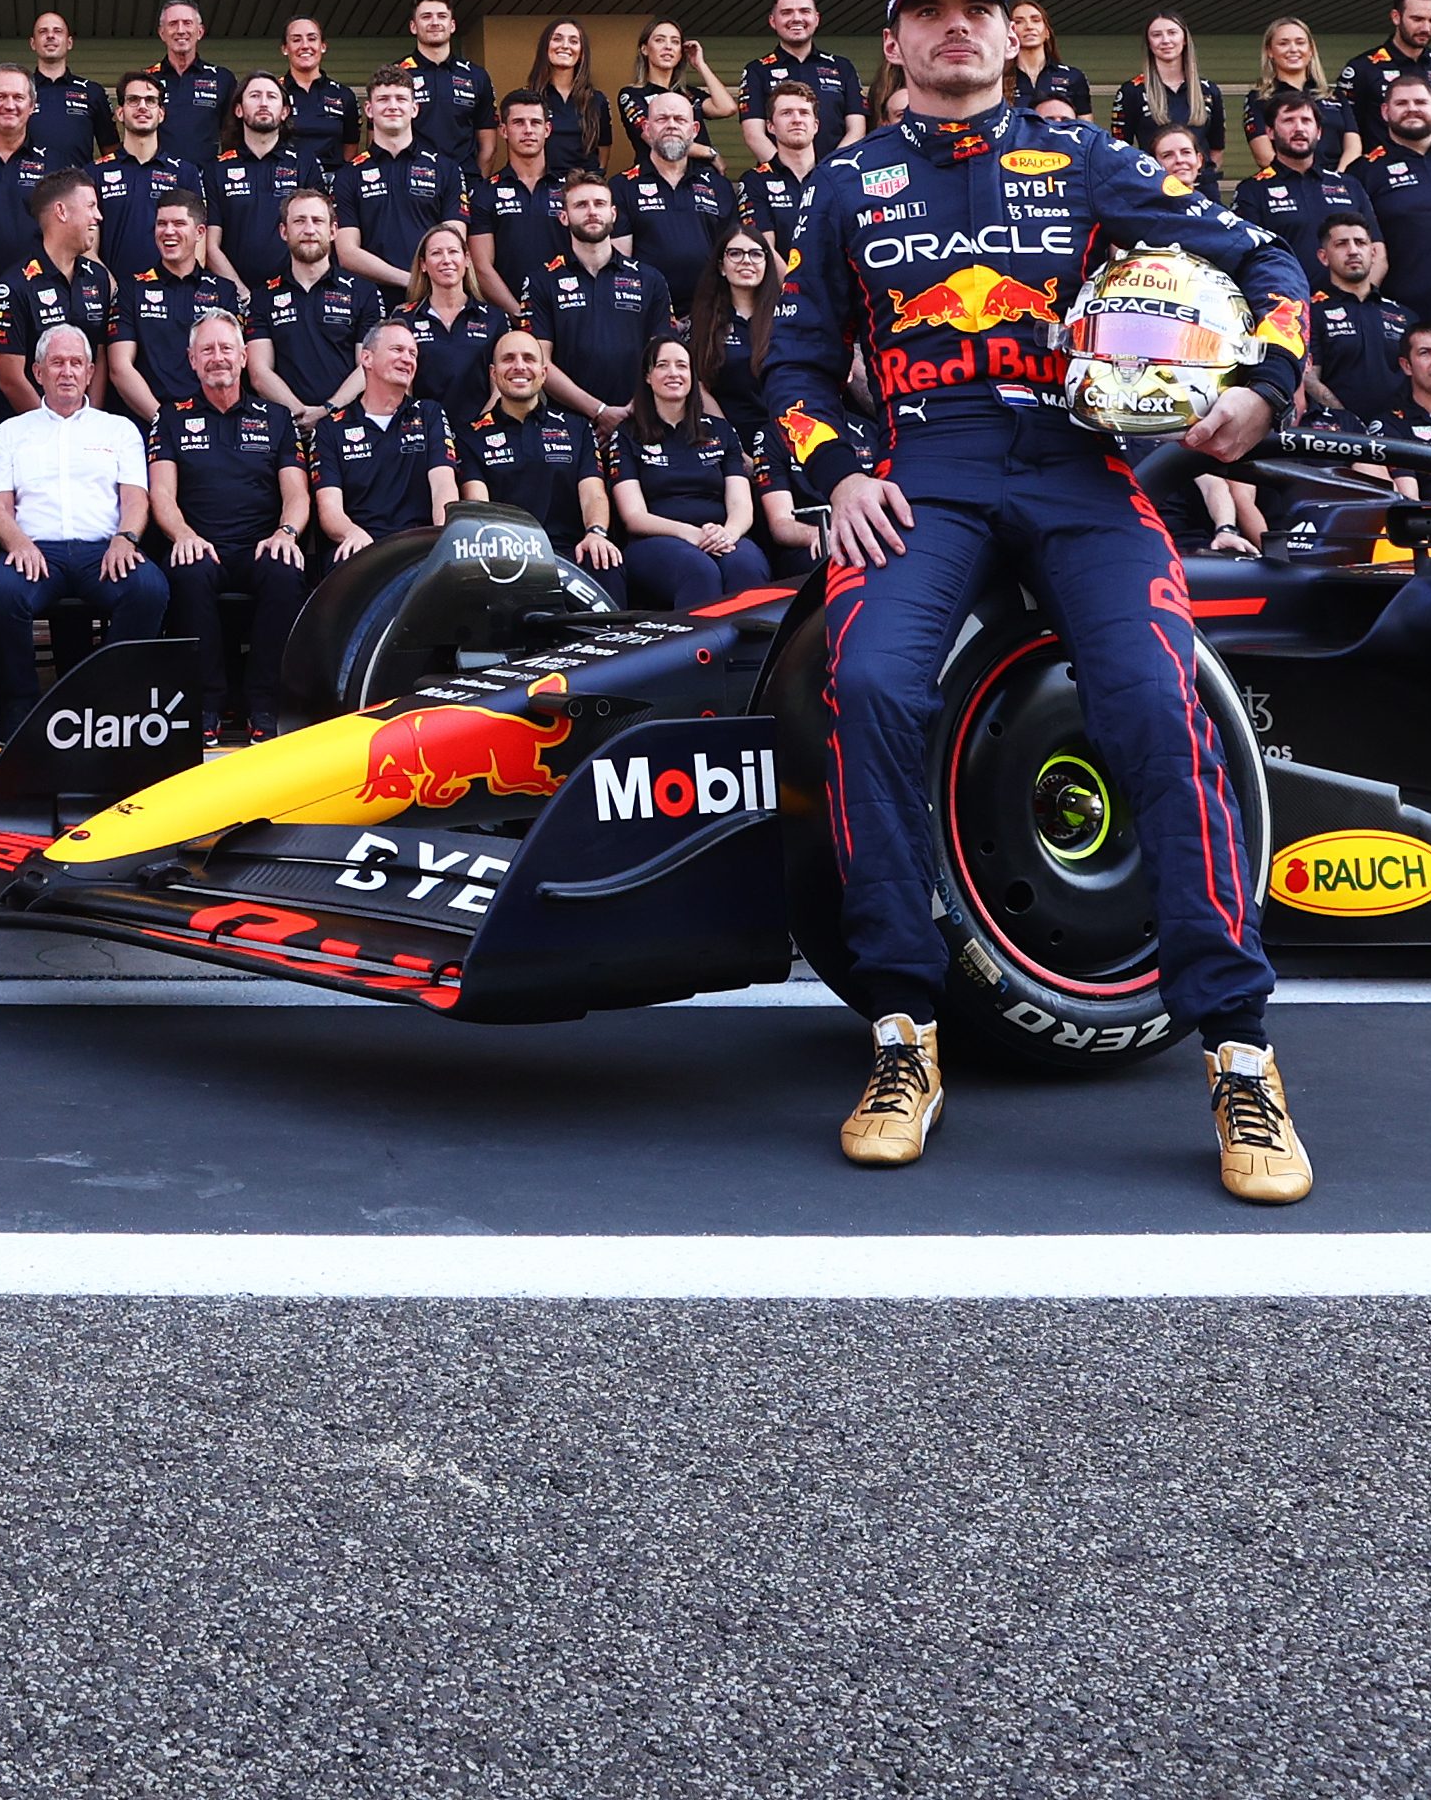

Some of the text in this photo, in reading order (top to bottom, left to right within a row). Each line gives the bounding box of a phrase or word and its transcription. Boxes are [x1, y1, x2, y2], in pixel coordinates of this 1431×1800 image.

[1019, 156, 1061, 168] RAUCH
[865, 168, 906, 185] TAG
[1004, 176, 1066, 197] BYBIT
[857, 202, 907, 228] Mobil
[1024, 205, 1070, 218] Tezos
[864, 225, 1075, 269] ORACLE
[1109, 274, 1178, 292] Red Bull
[1086, 297, 1195, 322] ORACLE
[879, 339, 975, 396] Red
[1084, 387, 1174, 413] CarNext
[181, 443, 210, 451] ORACLE
[1301, 434, 1363, 456] Tezos
[453, 534, 544, 560] Hard Rock
[46, 705, 171, 751] Claro
[592, 749, 777, 821] Mobil
[1313, 854, 1427, 893] RAUCH
